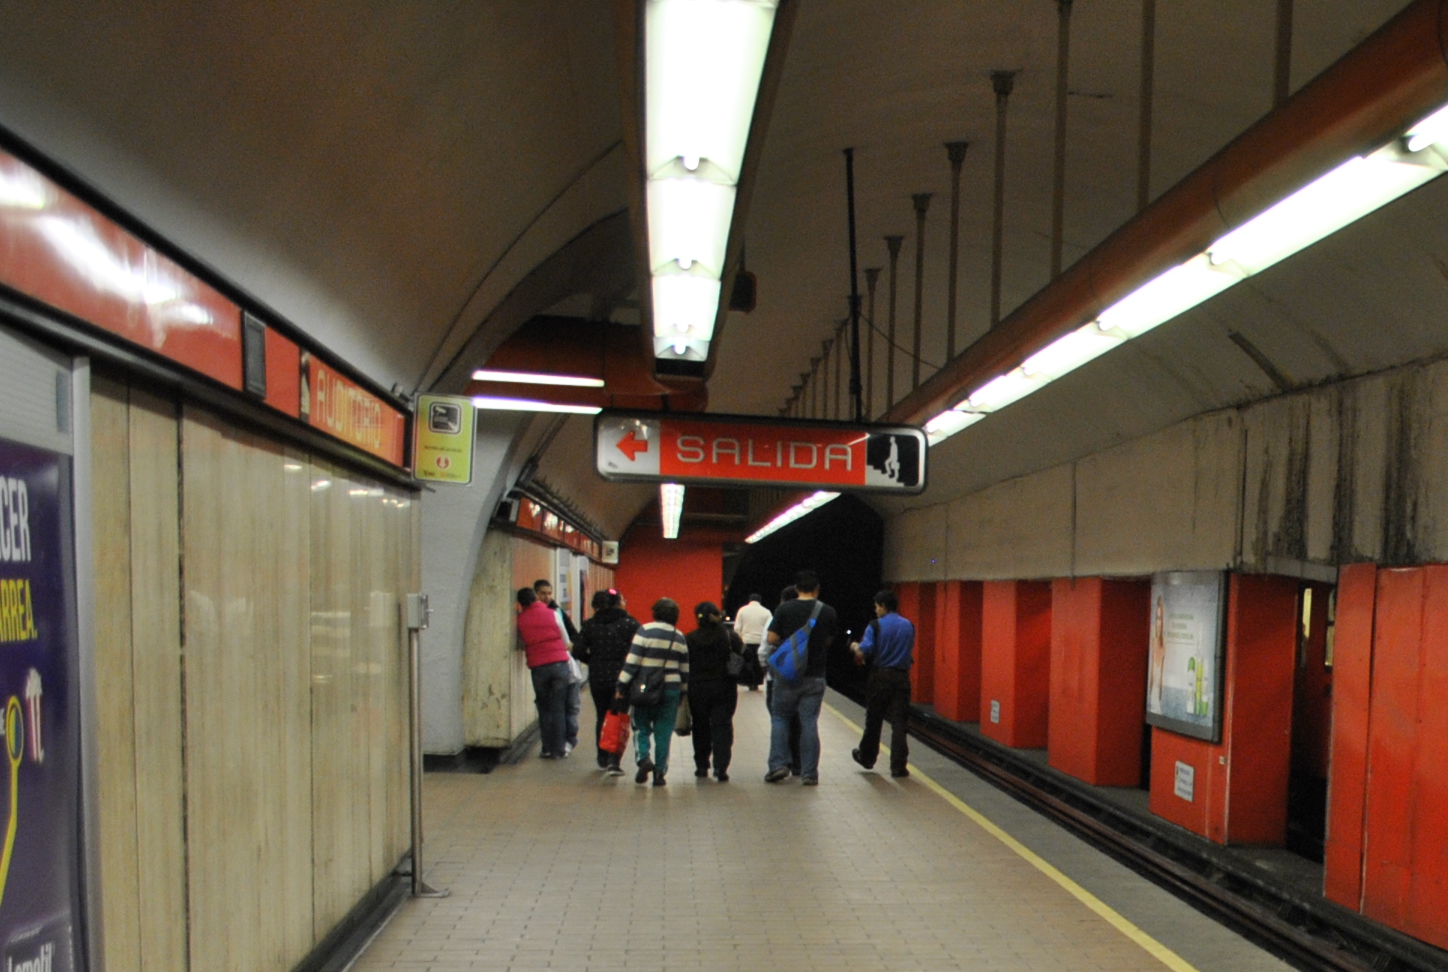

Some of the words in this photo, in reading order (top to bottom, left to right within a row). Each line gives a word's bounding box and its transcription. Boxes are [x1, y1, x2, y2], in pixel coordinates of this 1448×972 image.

[317, 369, 381, 449] AUDITORIO
[676, 435, 853, 472] SALIDA
[0, 475, 31, 562] CER
[0, 578, 38, 642] RREA.
